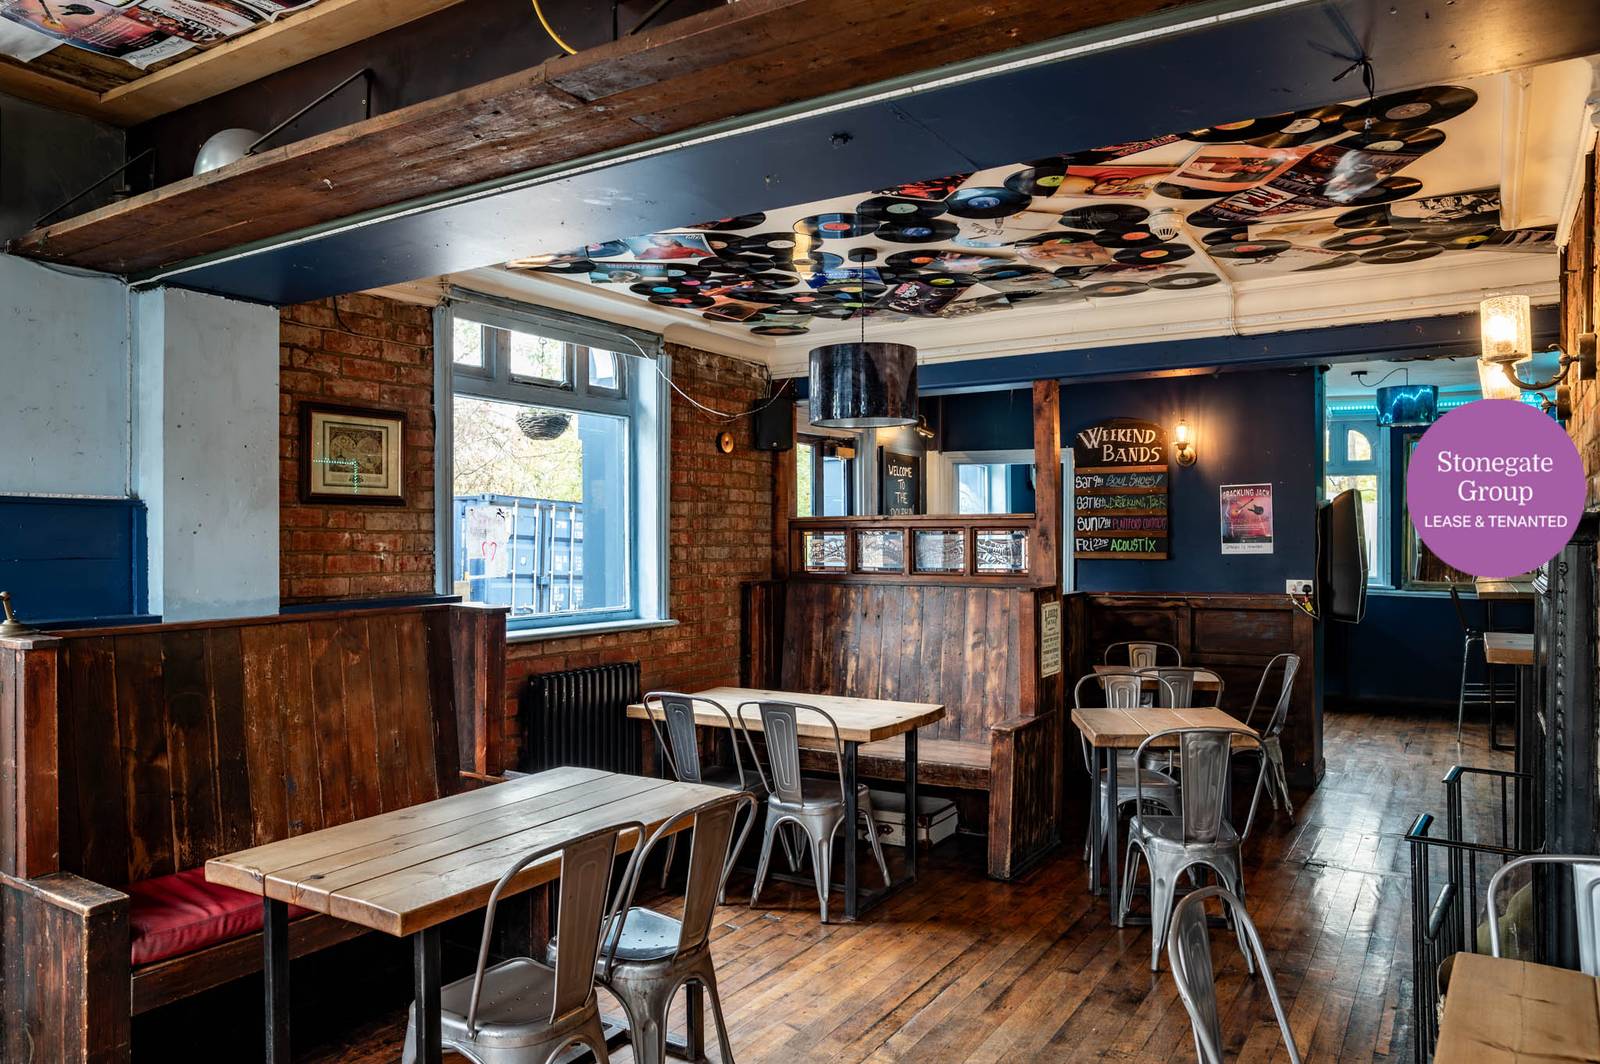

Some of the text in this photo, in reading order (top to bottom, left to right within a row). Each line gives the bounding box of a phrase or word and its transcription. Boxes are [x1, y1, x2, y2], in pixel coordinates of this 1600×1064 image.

[1078, 427, 1156, 449] WEEKEND
[1102, 444, 1162, 462] BANDS
[887, 464, 913, 478] WELCOME
[897, 479, 906, 490] TO
[894, 491, 909, 504] THE
